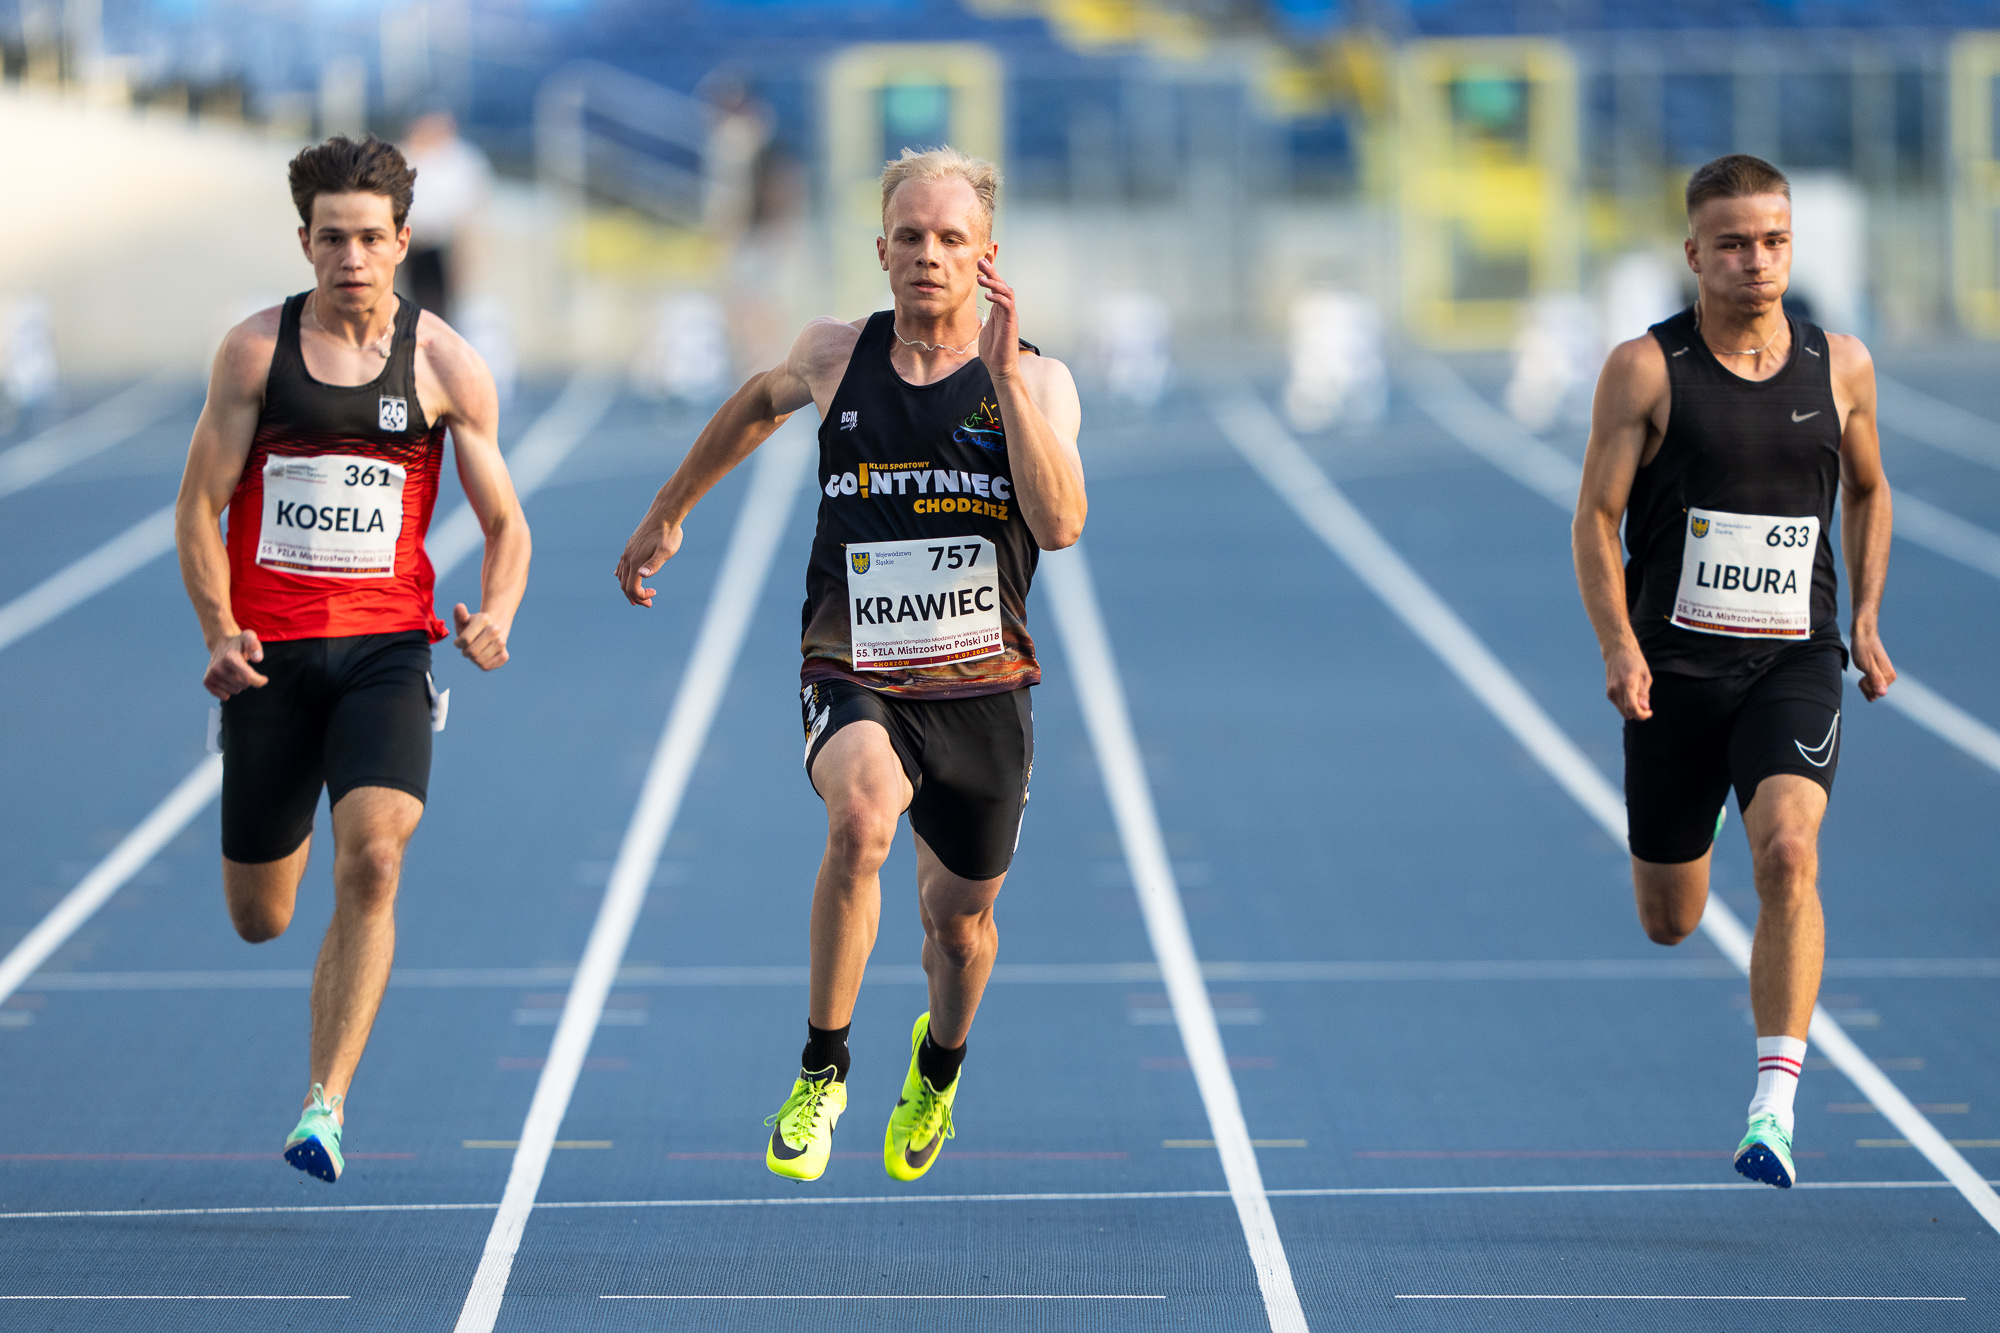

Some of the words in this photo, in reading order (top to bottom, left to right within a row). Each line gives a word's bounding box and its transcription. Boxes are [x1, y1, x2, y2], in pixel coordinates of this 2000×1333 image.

[841, 411, 858, 423] BCM
[344, 464, 391, 487] 361
[869, 462, 889, 470] KLUB
[890, 461, 930, 470] SPORTOWY
[276, 500, 384, 533] KOSELA
[913, 497, 1009, 520] CHODZIEŻ
[1766, 525, 1810, 548] 633
[277, 548, 297, 558] PZLA
[300, 551, 350, 563] Mistrzostwa
[875, 550, 912, 558] Województwo
[927, 543, 981, 571] 757
[1696, 561, 1797, 594] LIBURA
[855, 586, 994, 625] KRAWIEC
[1691, 607, 1712, 619] PZLA
[1716, 612, 1767, 624] Mistrzostwa
[856, 648, 870, 658] 55.
[872, 647, 895, 657] PZLA
[897, 643, 952, 656] Mistrzostwa
[954, 636, 981, 649] Polski
[983, 632, 1000, 643] U18
[867, 640, 903, 648] Ogólnopolska
[903, 637, 931, 645] Olimpiada
[873, 660, 910, 668] CHORZÓW
